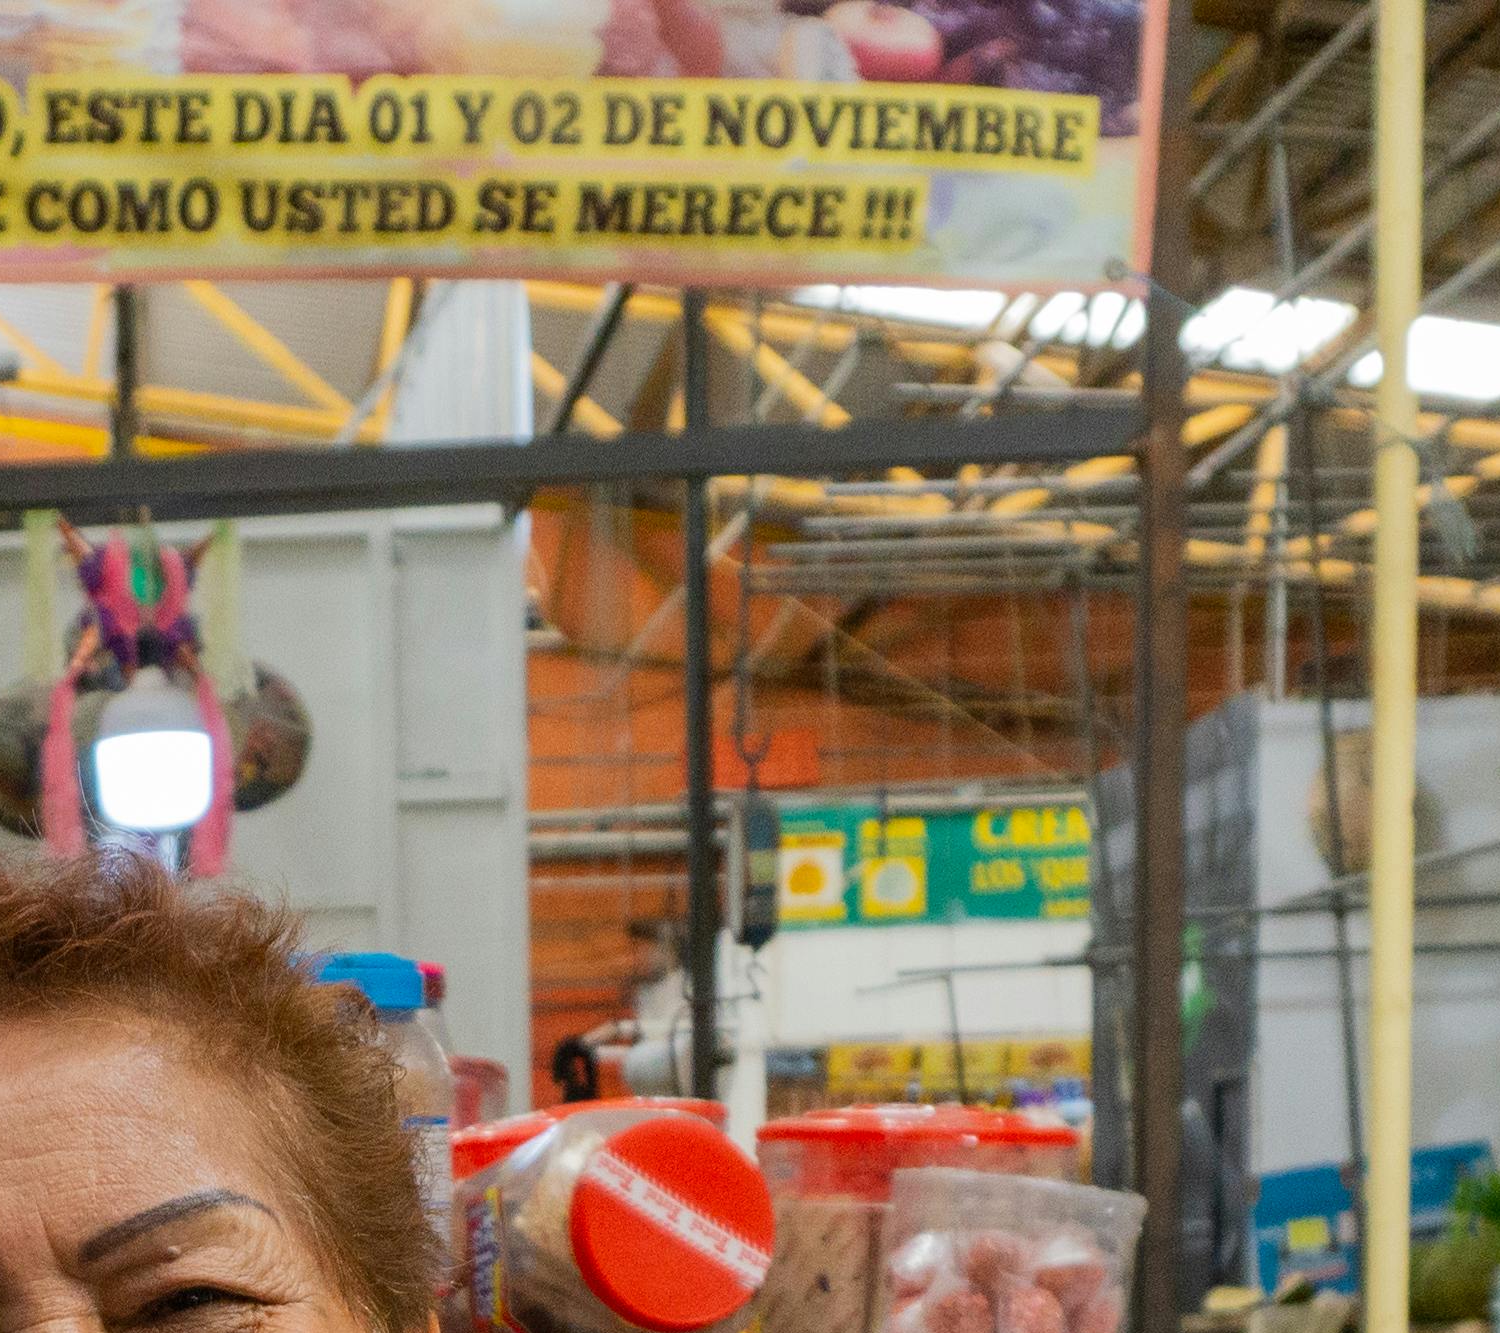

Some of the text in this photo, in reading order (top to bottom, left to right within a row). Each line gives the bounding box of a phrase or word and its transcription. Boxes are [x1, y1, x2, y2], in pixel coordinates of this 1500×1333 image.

[43, 88, 212, 146] ESTE
[231, 88, 351, 146] DIA
[368, 91, 431, 146] 01
[452, 91, 494, 145] Y
[511, 91, 584, 147] 02
[603, 93, 685, 148] DE
[701, 92, 1086, 165] NOVIEMBRE
[24, 175, 221, 235] COMO
[239, 178, 457, 235] USTED
[474, 177, 554, 236] SE
[575, 180, 849, 241] MERECE
[864, 187, 916, 242] !!!
